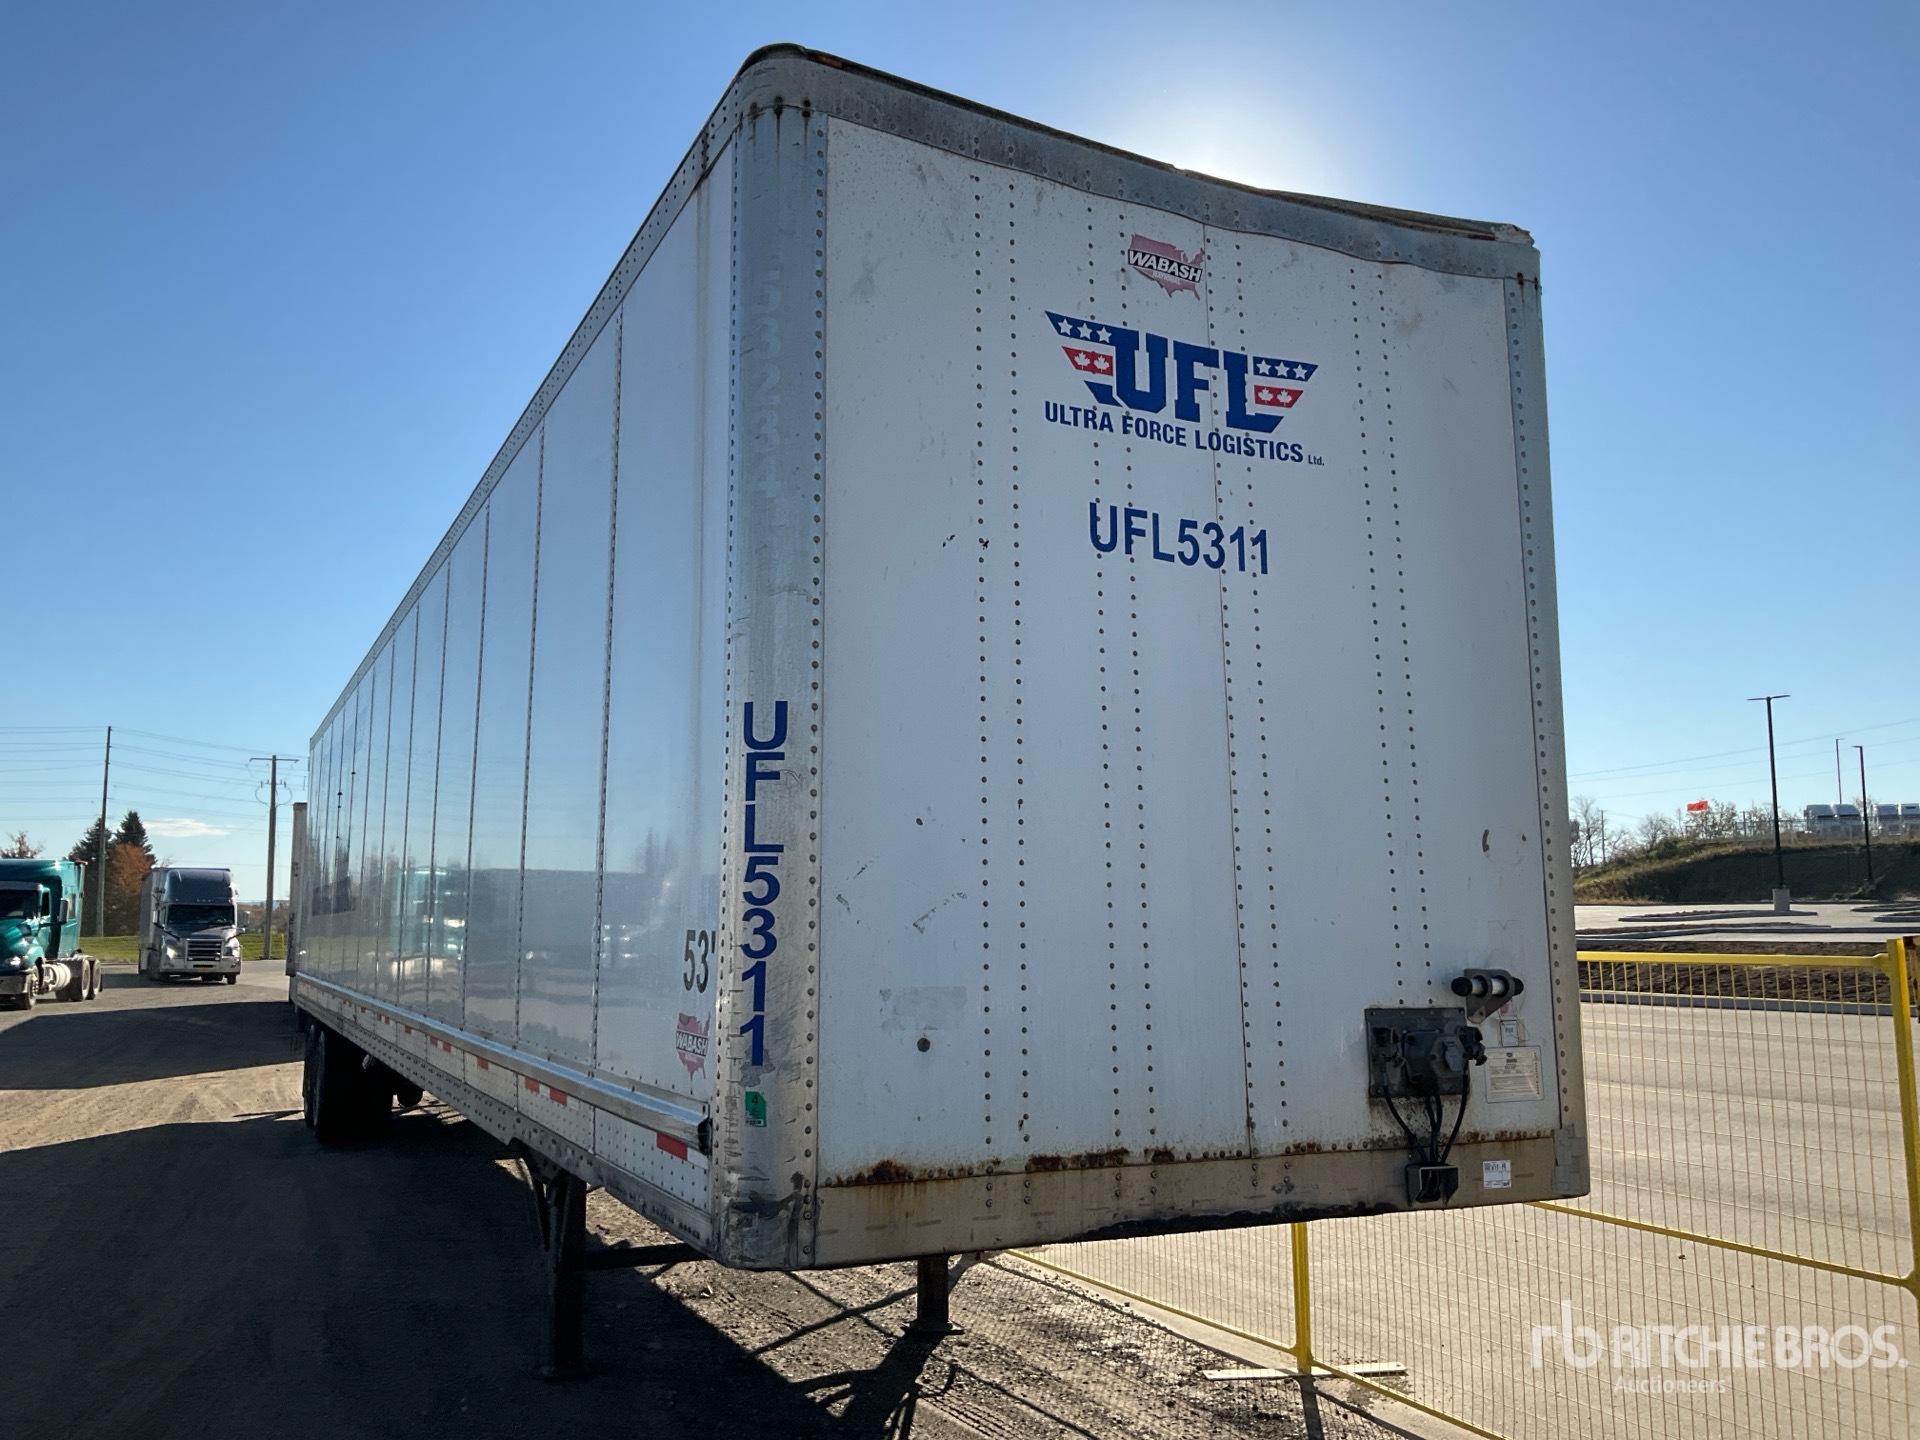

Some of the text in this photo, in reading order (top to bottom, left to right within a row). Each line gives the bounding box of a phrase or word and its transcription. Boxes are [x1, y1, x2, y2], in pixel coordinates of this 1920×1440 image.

[1128, 250, 1202, 282] WABASH
[1110, 325, 1285, 434] UFL
[1045, 400, 1325, 467] ULTRA FORCE LOGISTICS Ltd.
[1089, 501, 1269, 575] UFL5311
[741, 700, 788, 1067] UFL5311
[676, 1031, 708, 1057] WABASH
